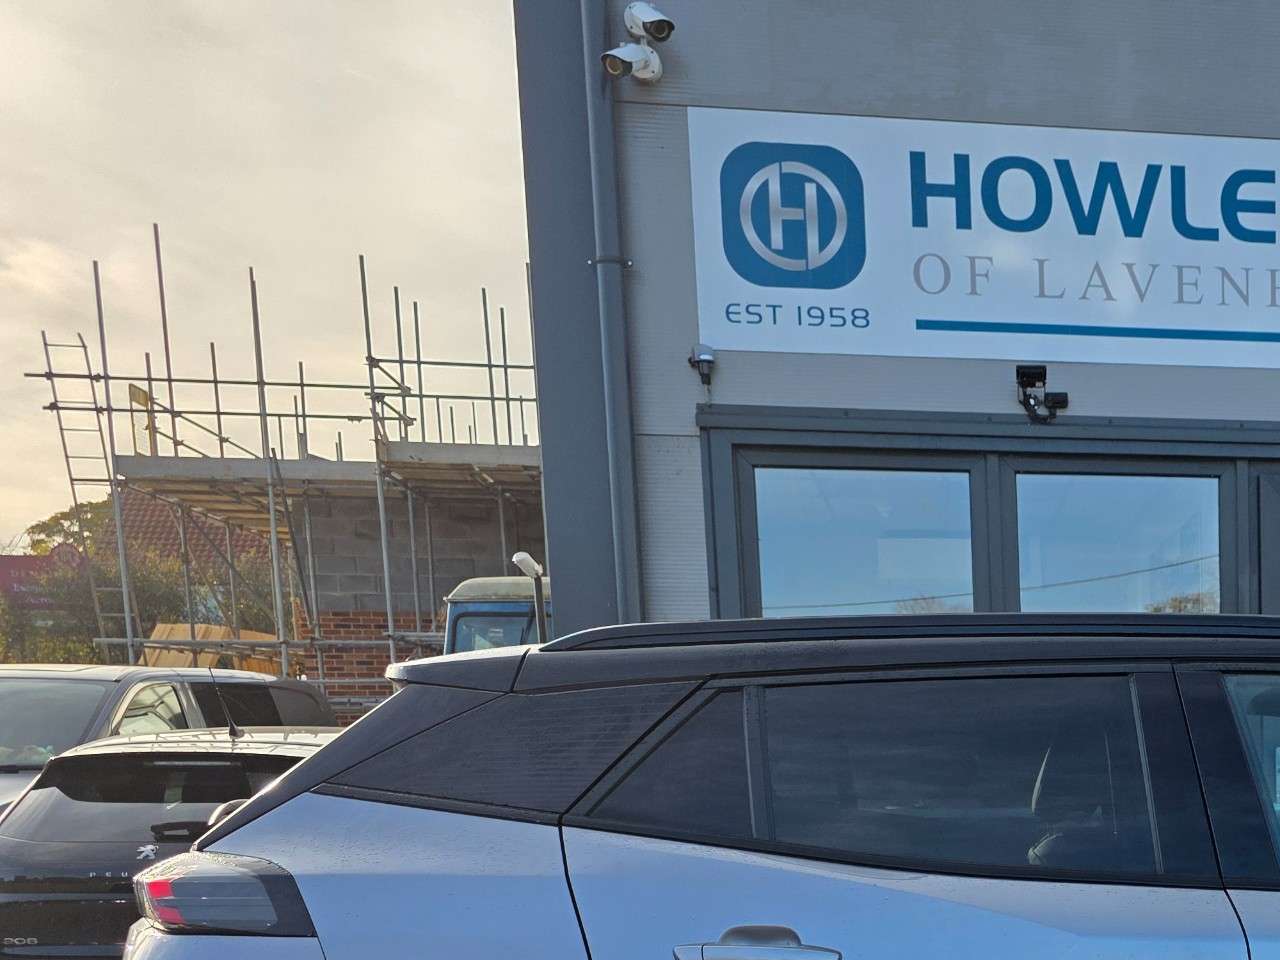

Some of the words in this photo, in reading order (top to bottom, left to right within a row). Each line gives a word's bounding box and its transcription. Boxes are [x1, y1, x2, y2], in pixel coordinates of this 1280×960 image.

[912, 252, 995, 297] OF
[725, 303, 783, 325] EST
[797, 305, 871, 329] 1958
